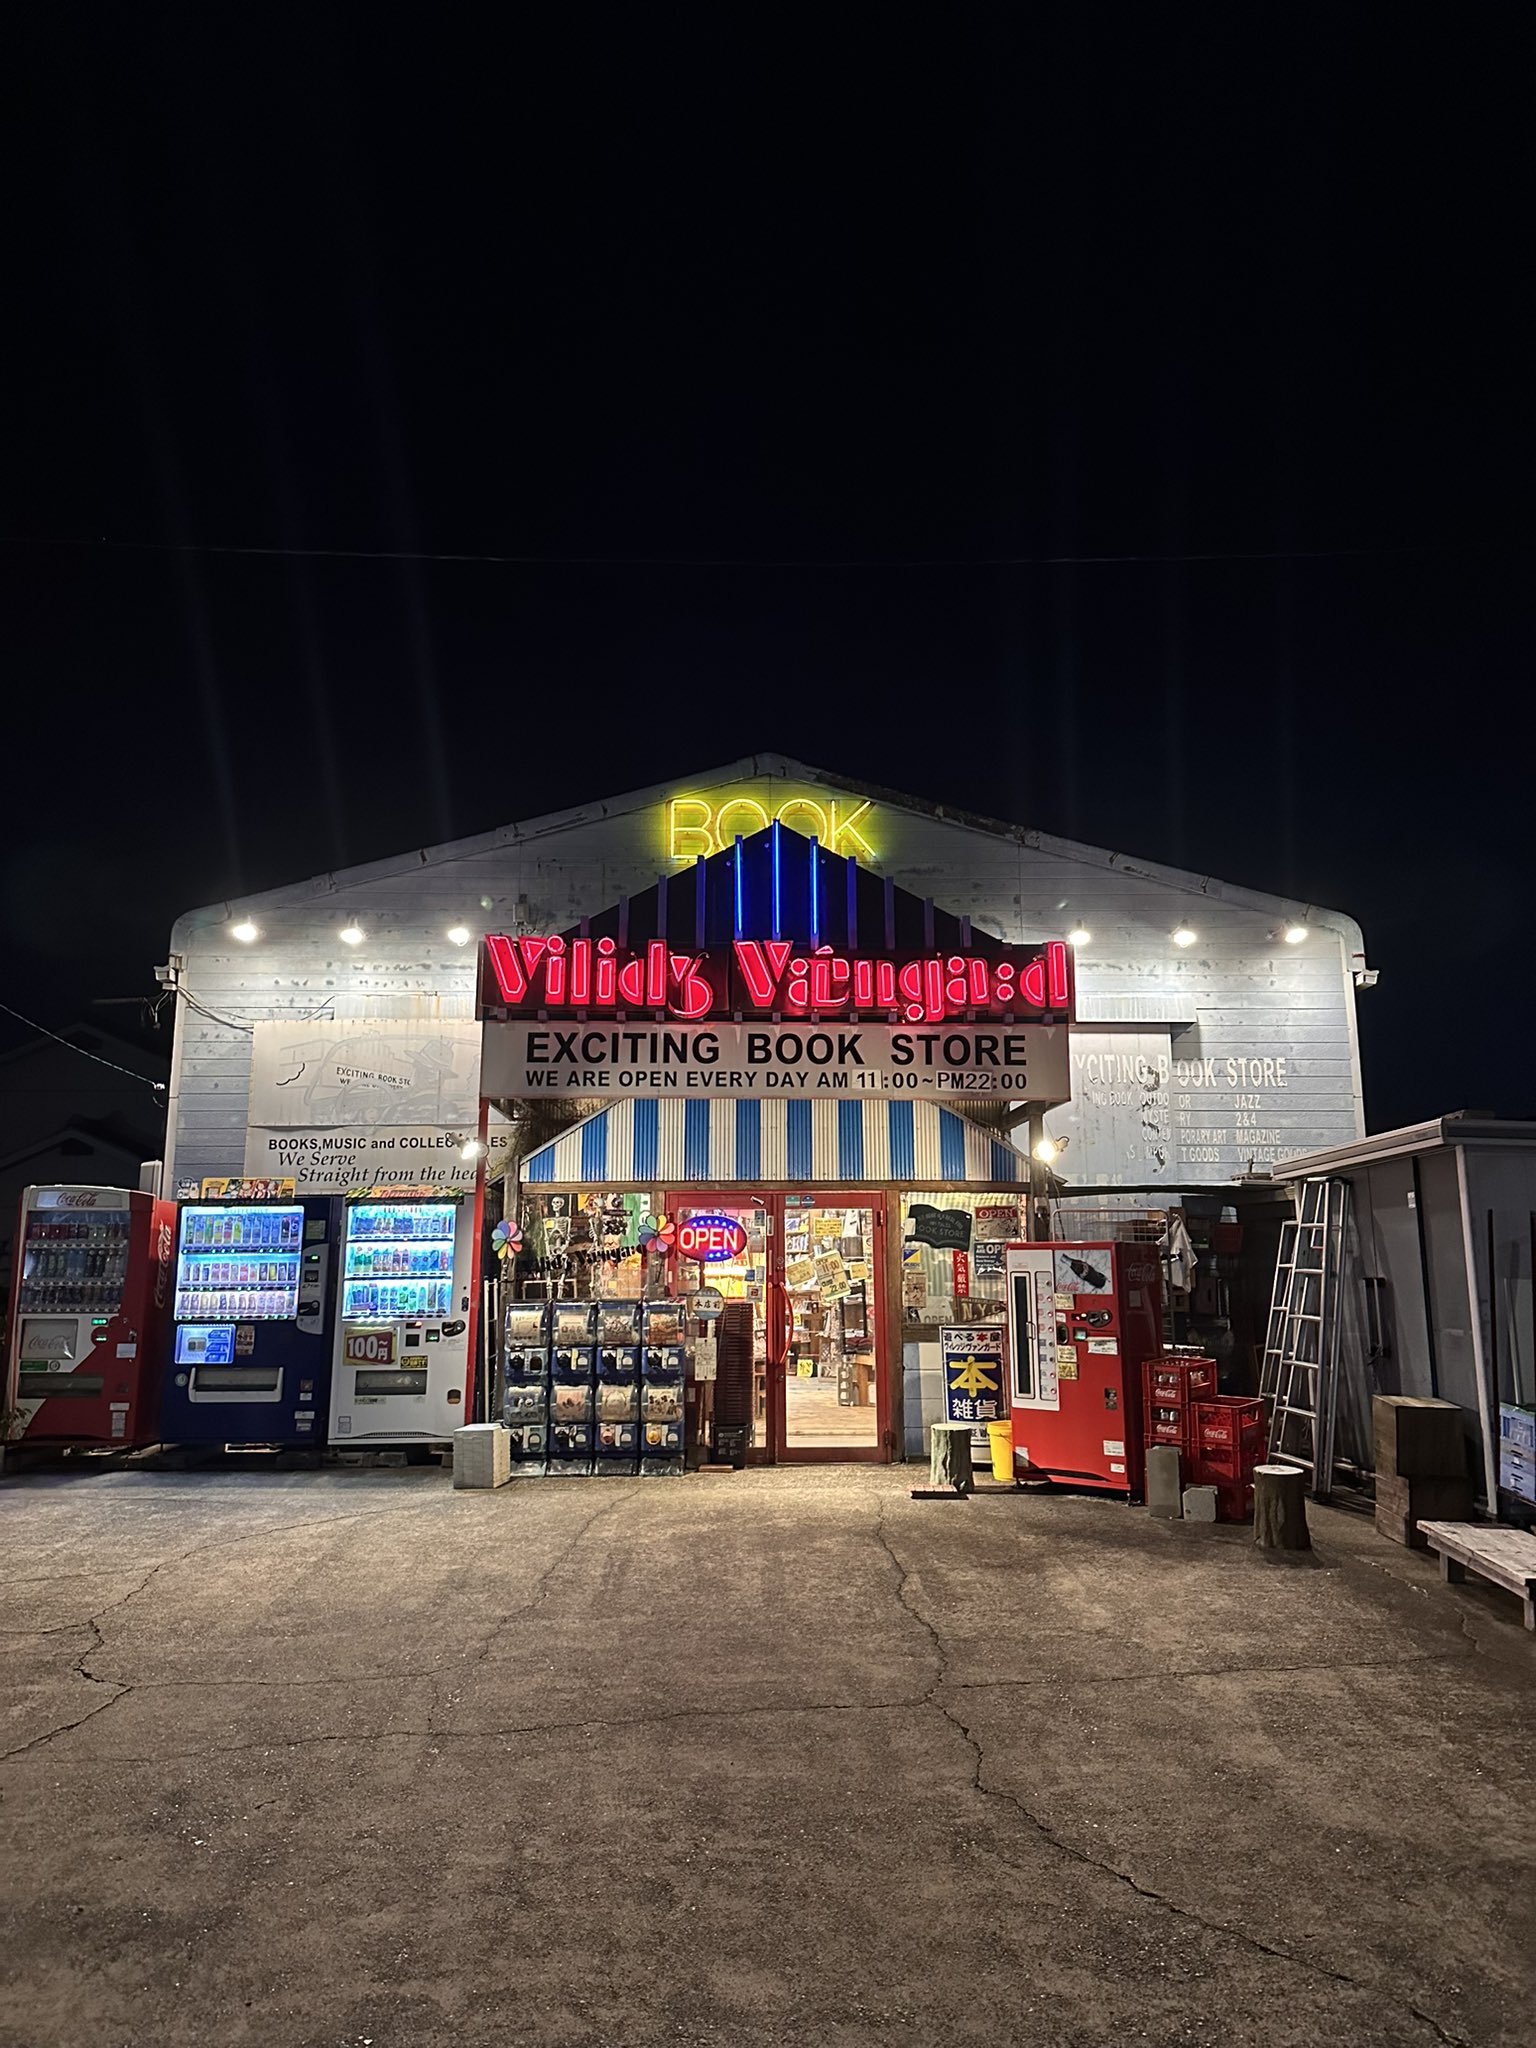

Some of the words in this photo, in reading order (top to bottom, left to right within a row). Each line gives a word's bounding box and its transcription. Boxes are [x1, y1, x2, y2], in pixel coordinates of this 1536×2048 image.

[671, 798, 877, 859] BOOK
[526, 1032, 720, 1064] EXCITING
[747, 1032, 865, 1064] BOOK
[890, 1034, 1027, 1066] STORE
[336, 1066, 375, 1080] EXCITING
[377, 1073, 397, 1084] BOOK
[525, 1070, 559, 1087] WE
[566, 1070, 611, 1087] ARE
[618, 1070, 678, 1087] OPEN
[686, 1071, 758, 1088] EVERY
[765, 1071, 809, 1088] DAY
[816, 1071, 849, 1088] AM
[1226, 1057, 1288, 1088] STORE
[1234, 1094, 1262, 1109] JAZZ
[1235, 1111, 1257, 1126] 2&4
[371, 1137, 395, 1149] and
[1236, 1129, 1281, 1144] MAGAZINE
[279, 1151, 306, 1166] We
[310, 1151, 357, 1166] Serve
[1189, 1148, 1220, 1162] GOODS
[1237, 1147, 1276, 1162] VINTAGE
[298, 1167, 370, 1187] Straight
[371, 1166, 414, 1187] from
[420, 1166, 446, 1181] the
[979, 1207, 1014, 1218] OPEN
[918, 1225, 938, 1235] OOK
[680, 1227, 738, 1251] OPEN
[822, 1260, 840, 1273] 11:00
[949, 1355, 998, 1398] 本
[952, 1398, 998, 1420] 雑貨
